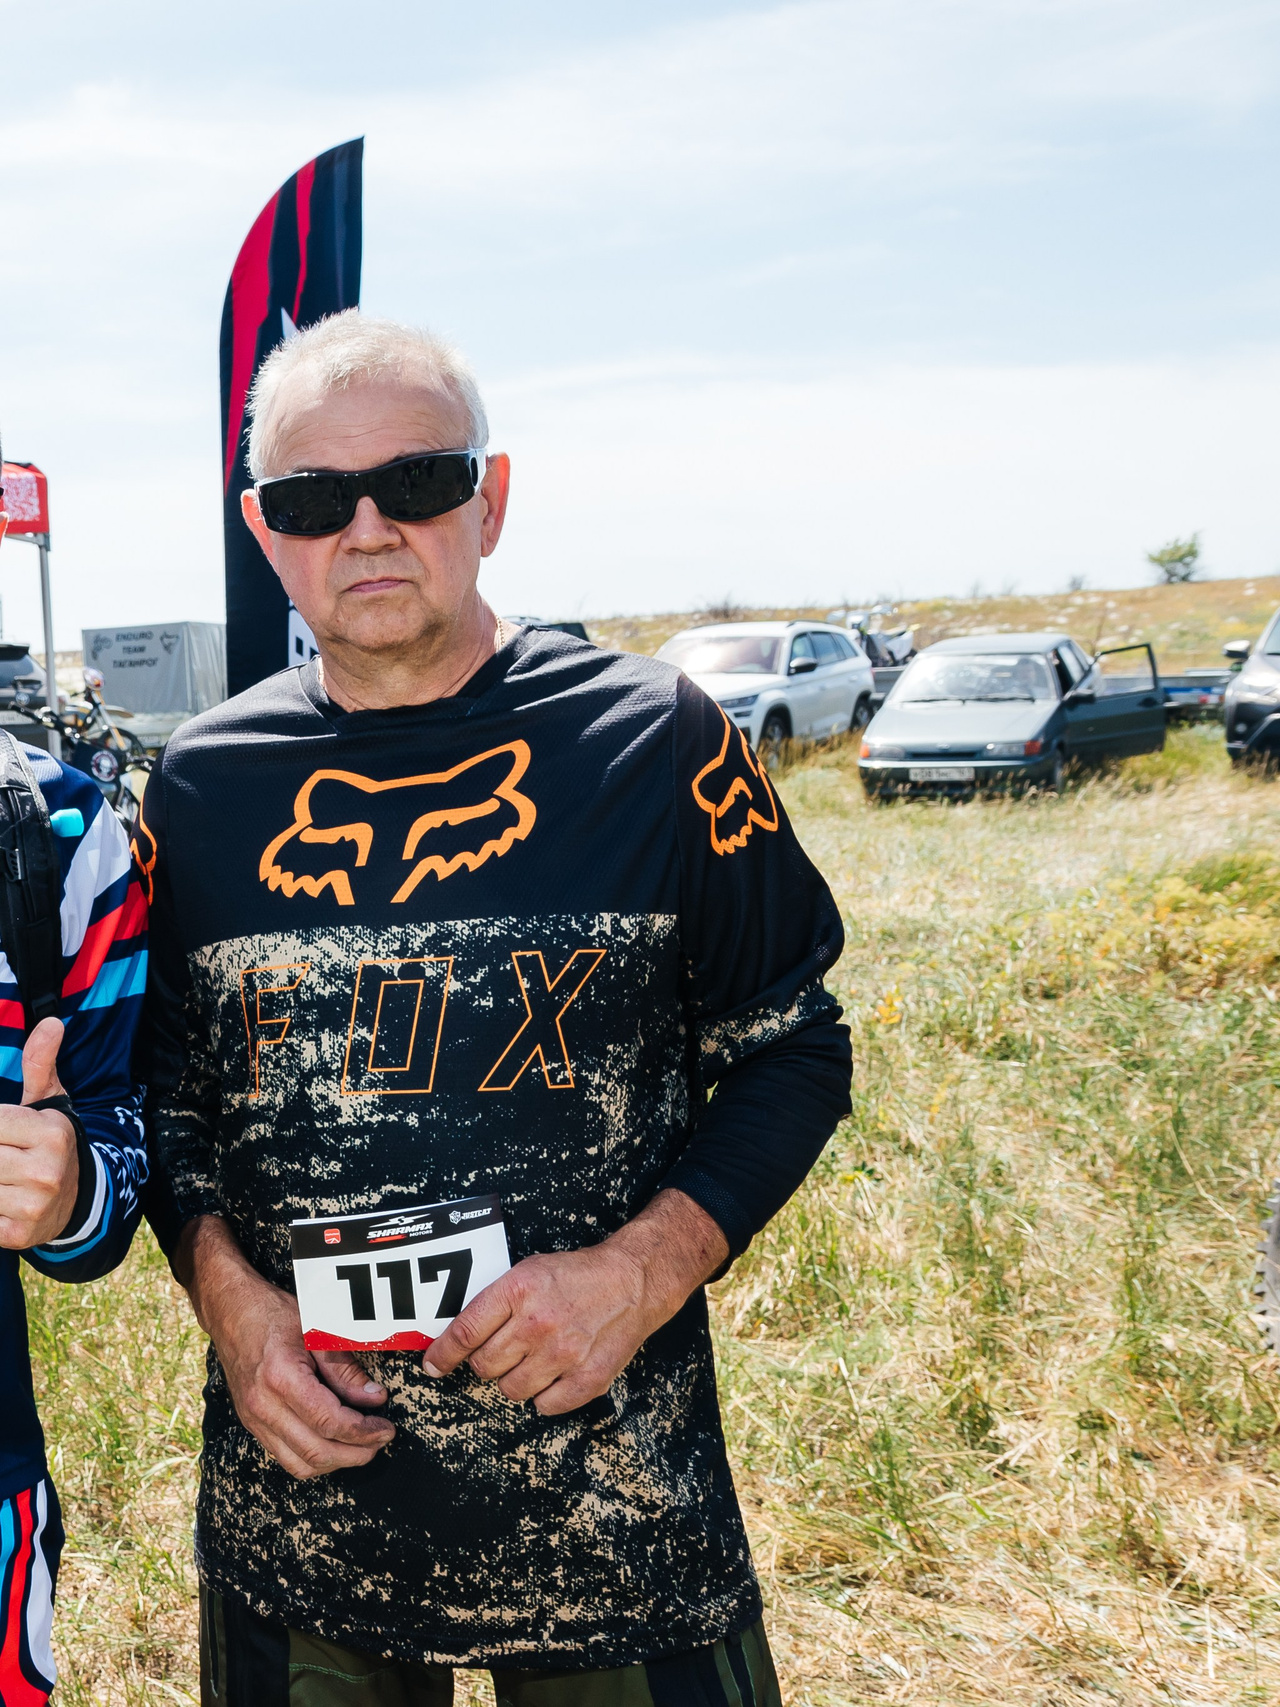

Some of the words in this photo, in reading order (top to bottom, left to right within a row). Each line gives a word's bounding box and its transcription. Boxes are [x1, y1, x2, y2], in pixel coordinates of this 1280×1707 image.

[115, 630, 154, 642] ENDURO
[122, 646, 147, 654] TEAM
[240, 949, 607, 1099] FOX
[366, 1221, 434, 1239] SHARMAX
[409, 1229, 433, 1238] MOTORS
[335, 1248, 473, 1321] 117
